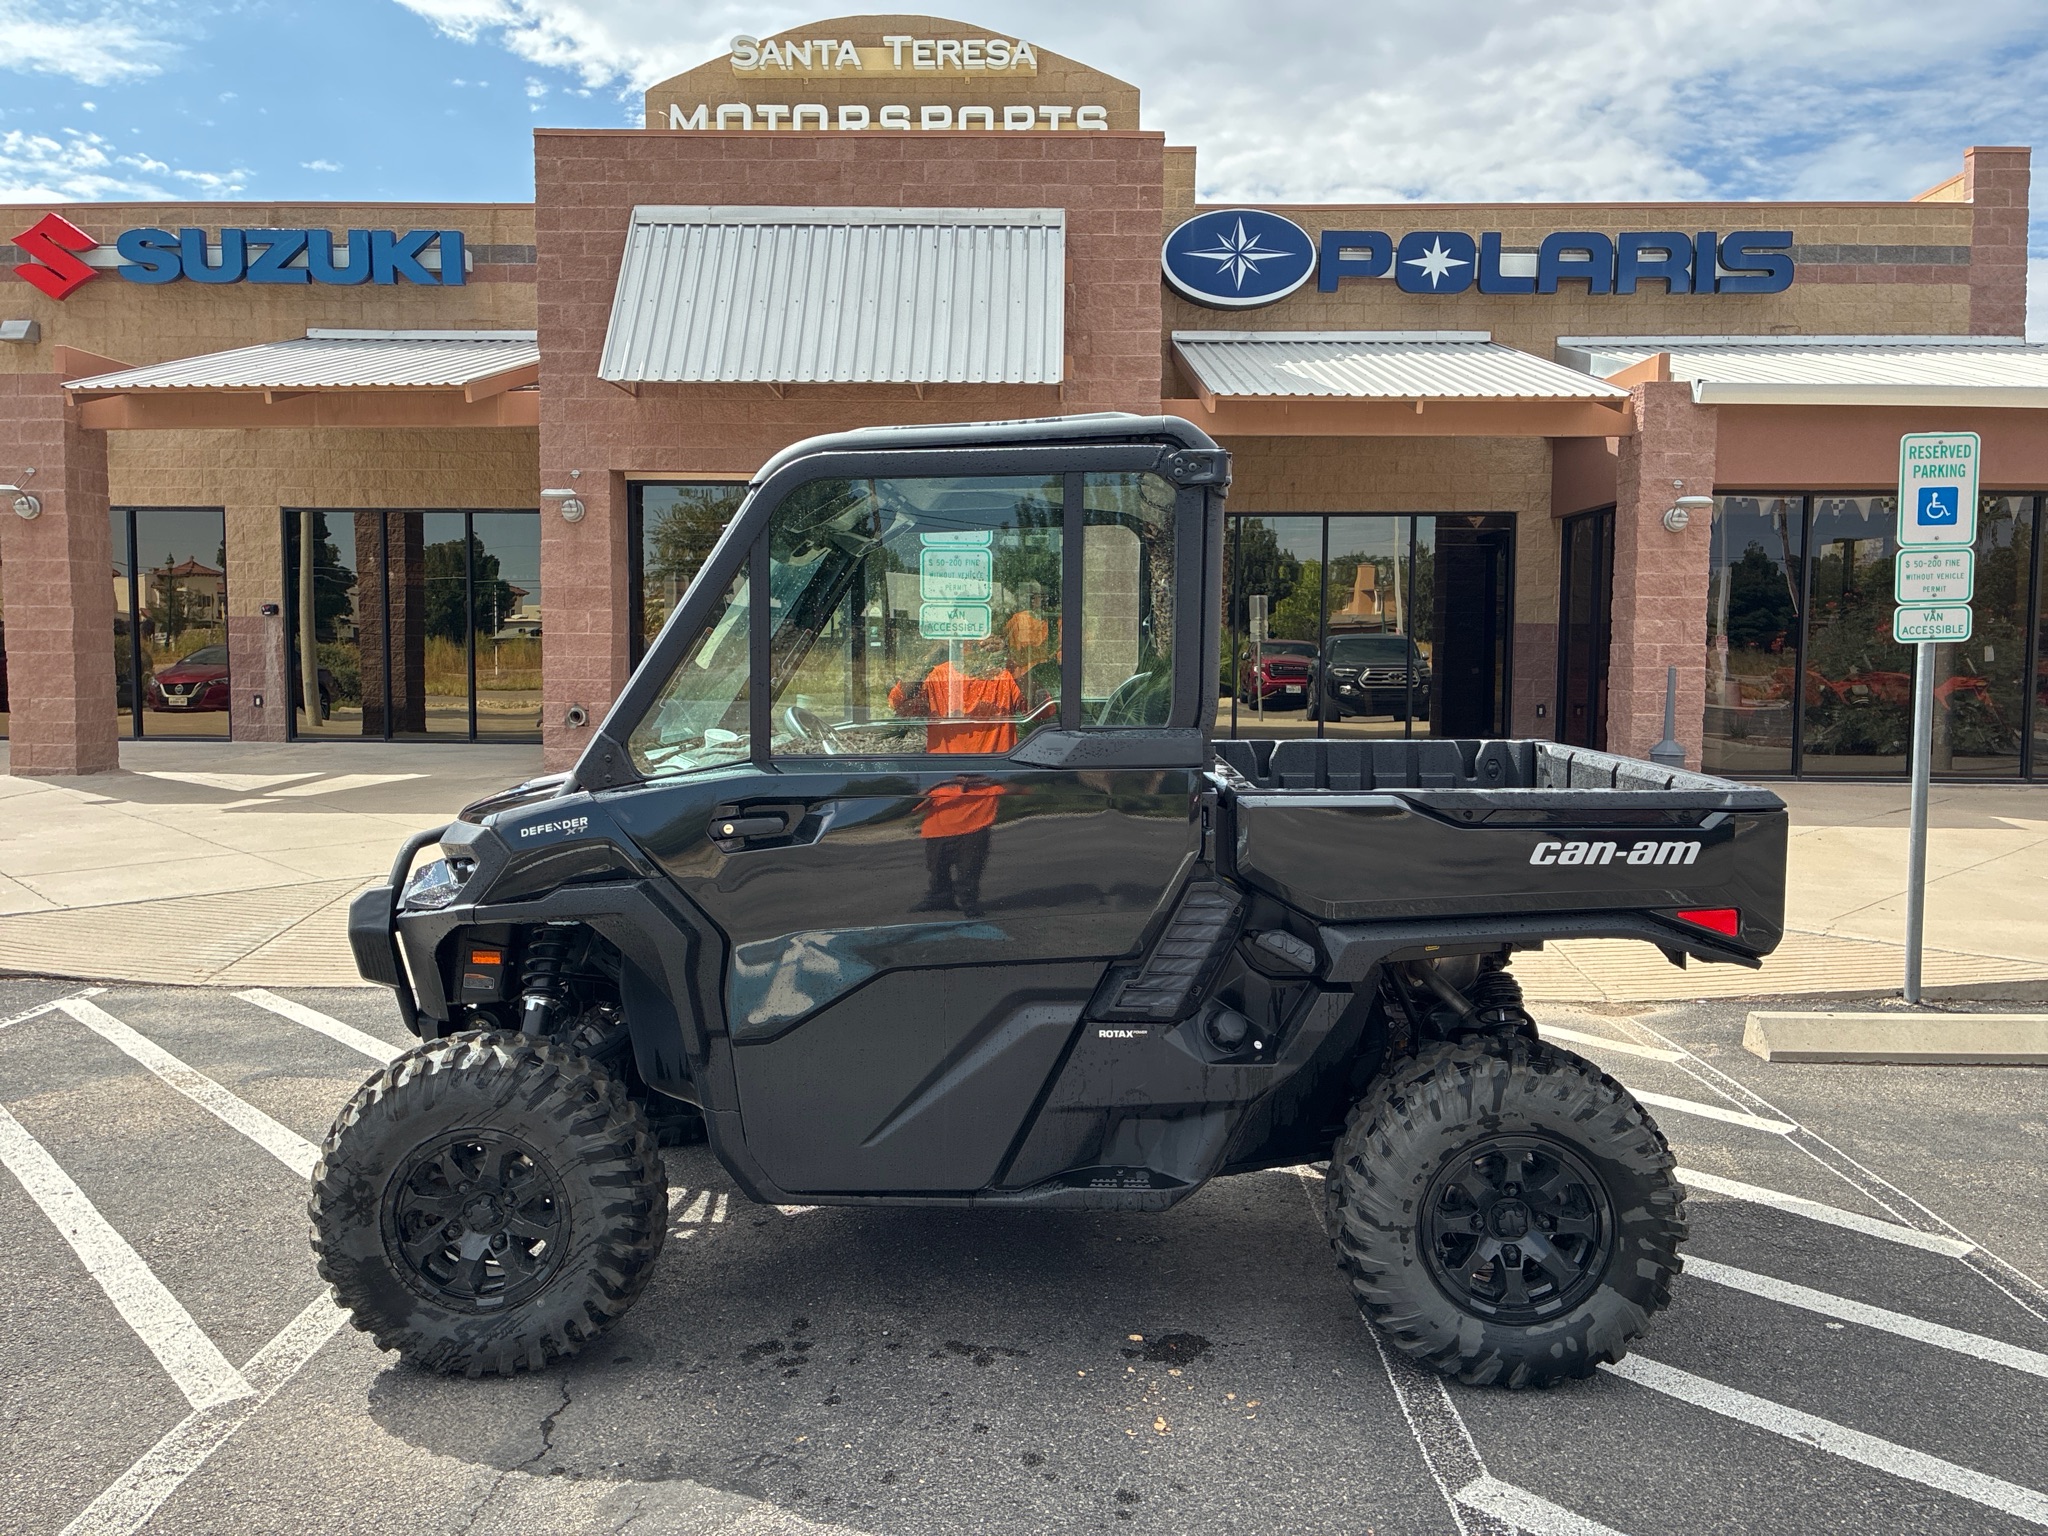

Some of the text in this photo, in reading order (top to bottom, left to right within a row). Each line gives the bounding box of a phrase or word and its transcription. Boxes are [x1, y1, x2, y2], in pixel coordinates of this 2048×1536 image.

[729, 34, 1037, 71] SANTA TERESA
[117, 228, 466, 286] SUZUKI
[1318, 230, 1795, 294] POLARIS
[1908, 444, 1972, 460] RESERVED
[1912, 463, 1967, 479] PARKING
[965, 559, 980, 567] FINE
[1913, 559, 1942, 568] 50-200
[1945, 559, 1961, 567] FINE
[1936, 572, 1965, 580] VEHICLE
[1922, 585, 1947, 593] PERMIT
[947, 611, 966, 620] VAN
[1923, 612, 1944, 622] VAN
[926, 622, 985, 633] ACCESSIBLE
[1901, 624, 1964, 636] ACCESSIBLE
[520, 816, 589, 838] DEFENDER
[565, 825, 589, 836] XT
[1529, 841, 1702, 866] can-am
[1098, 1029, 1134, 1039] ROTAX
